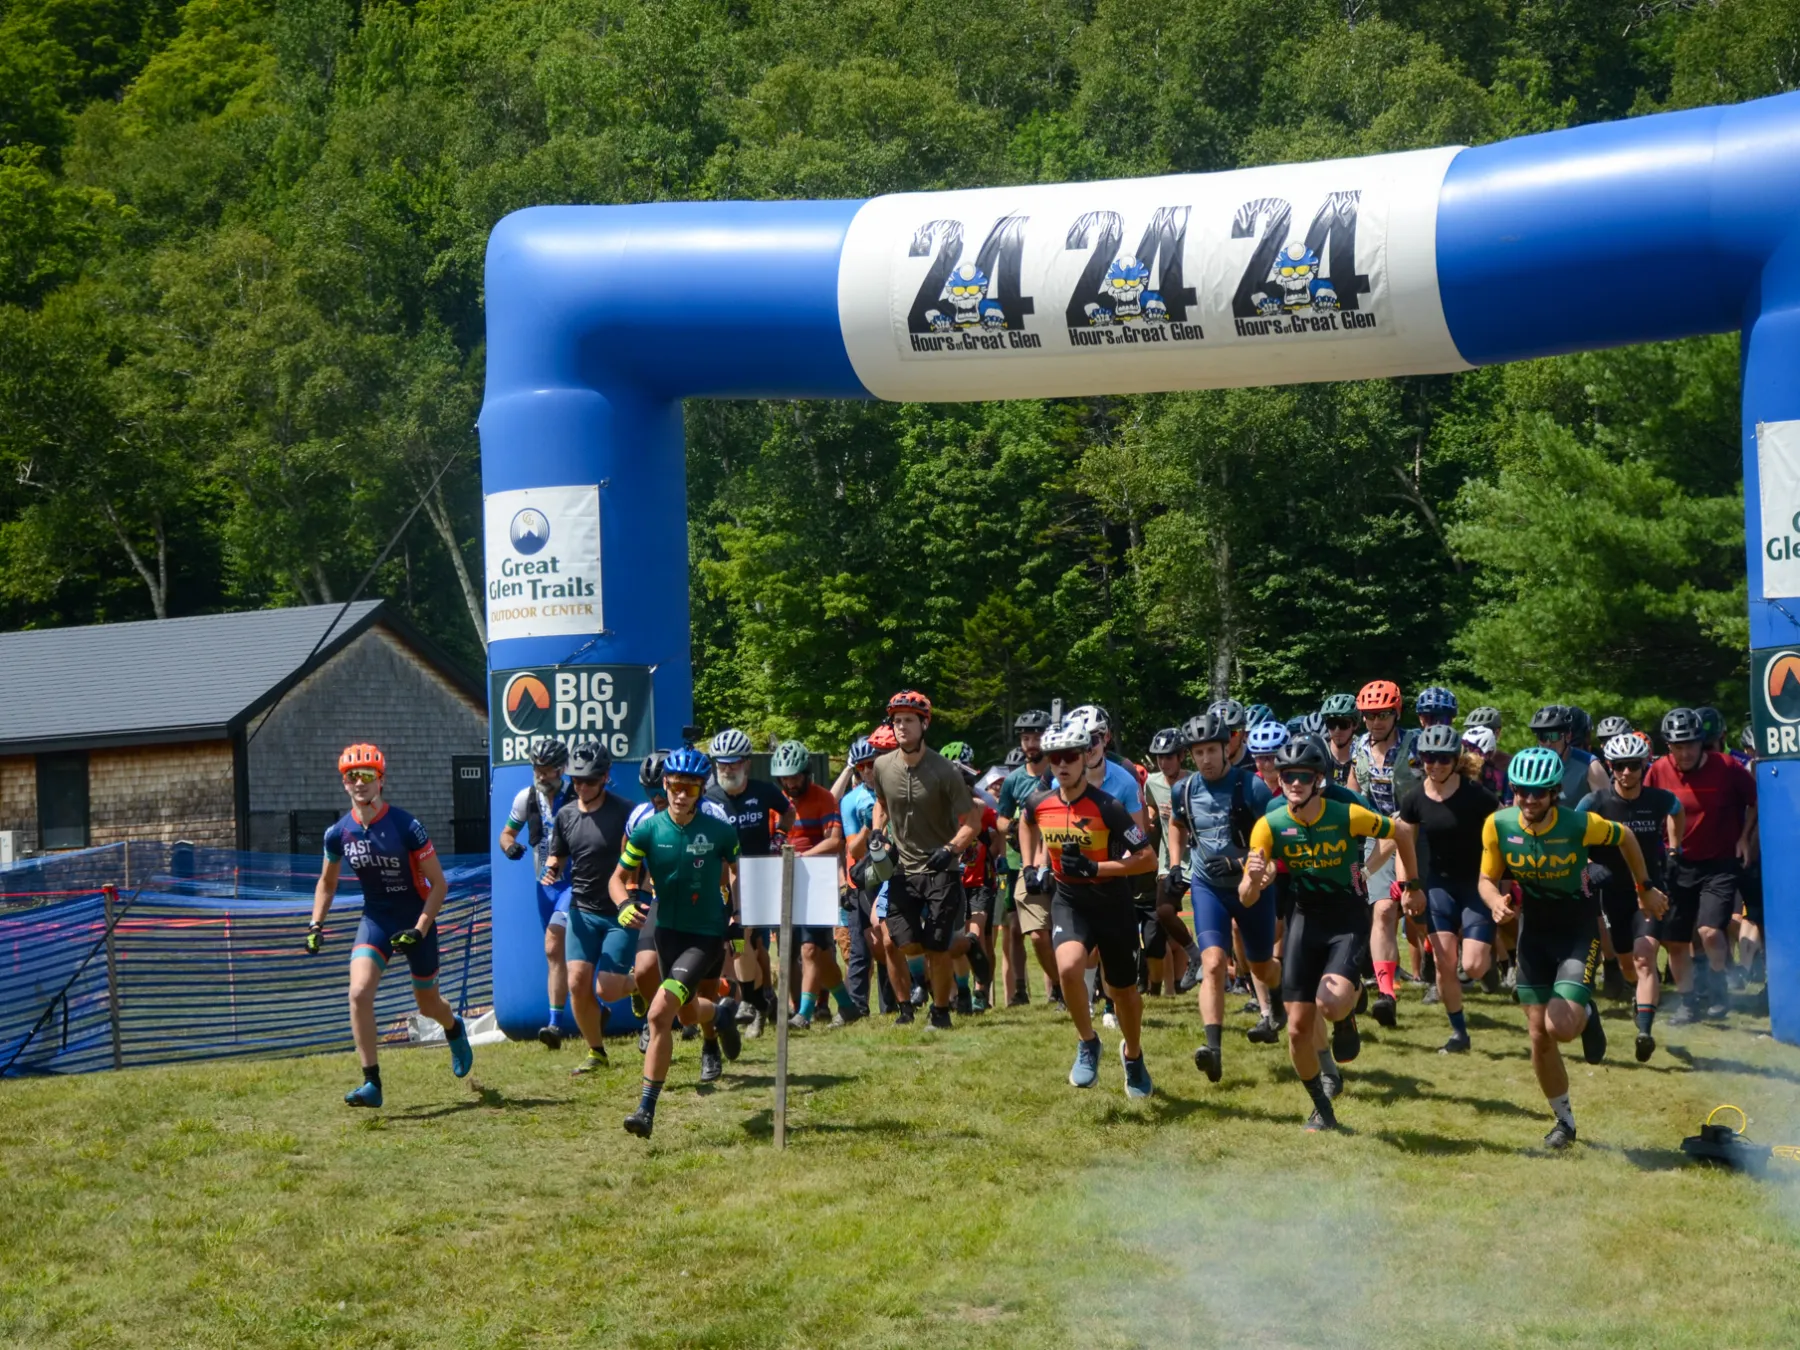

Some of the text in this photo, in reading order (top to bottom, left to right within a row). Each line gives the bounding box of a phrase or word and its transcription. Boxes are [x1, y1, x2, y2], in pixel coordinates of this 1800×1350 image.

[1231, 189, 1371, 318] 24
[908, 215, 1035, 334] 24
[1065, 205, 1198, 328] 24
[1234, 311, 1376, 337] Hours of Great Glen
[910, 331, 1042, 352] Hours of Great Glen
[1068, 324, 1204, 346] Hours of Great Glen
[501, 556, 560, 577] Great
[489, 577, 595, 600] Glen Trails
[491, 603, 593, 623] OUTDOOR CENTER
[555, 672, 613, 702] BIG
[555, 701, 628, 731] DAY
[1767, 725, 1800, 754] BR
[738, 811, 763, 825] pigs
[344, 840, 371, 857] FAST
[1045, 832, 1093, 846] HAWKS
[1284, 839, 1348, 858] UVM
[350, 854, 401, 870] SPLITS
[1289, 857, 1342, 869] CYCLING
[1506, 852, 1577, 868] UVM
[1582, 938, 1601, 984] VERMONT
